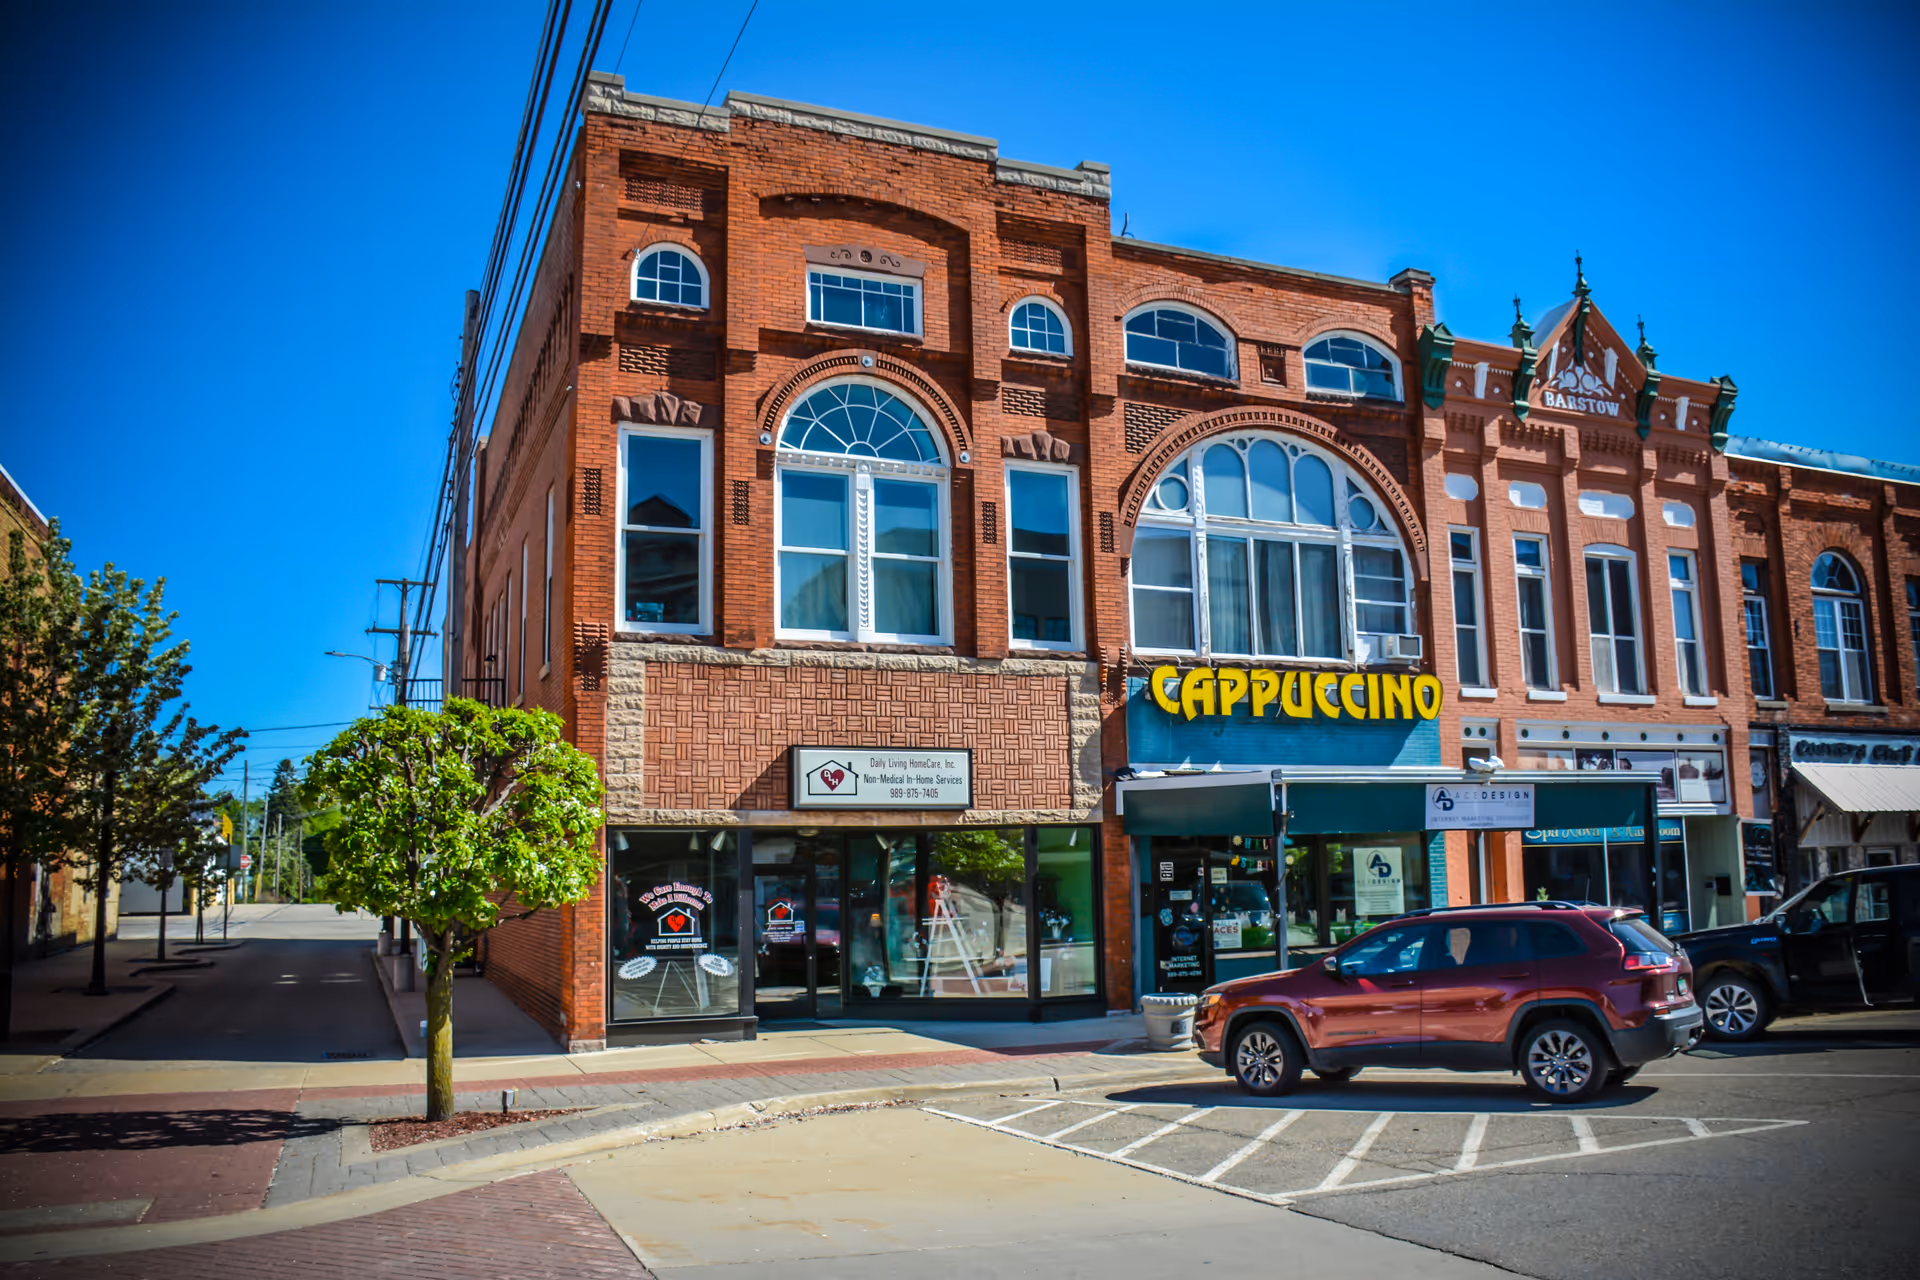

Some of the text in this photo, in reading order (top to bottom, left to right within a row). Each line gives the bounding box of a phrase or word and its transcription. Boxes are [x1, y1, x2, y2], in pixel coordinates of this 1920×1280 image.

[1544, 391, 1619, 417] BARSTOW
[1150, 665, 1444, 721] CAPPUCCINO
[870, 758, 956, 770] Daily Living HomeCare, Inc.
[863, 774, 963, 785] Non-Medical In-Home Services
[890, 788, 939, 798] 989-875-7405
[1659, 827, 1681, 837] oom
[639, 881, 714, 904] We Care Enough To
[648, 893, 705, 912] Make A Difference
[1213, 926, 1240, 937] ACES
[1168, 961, 1200, 969] MARKETING
